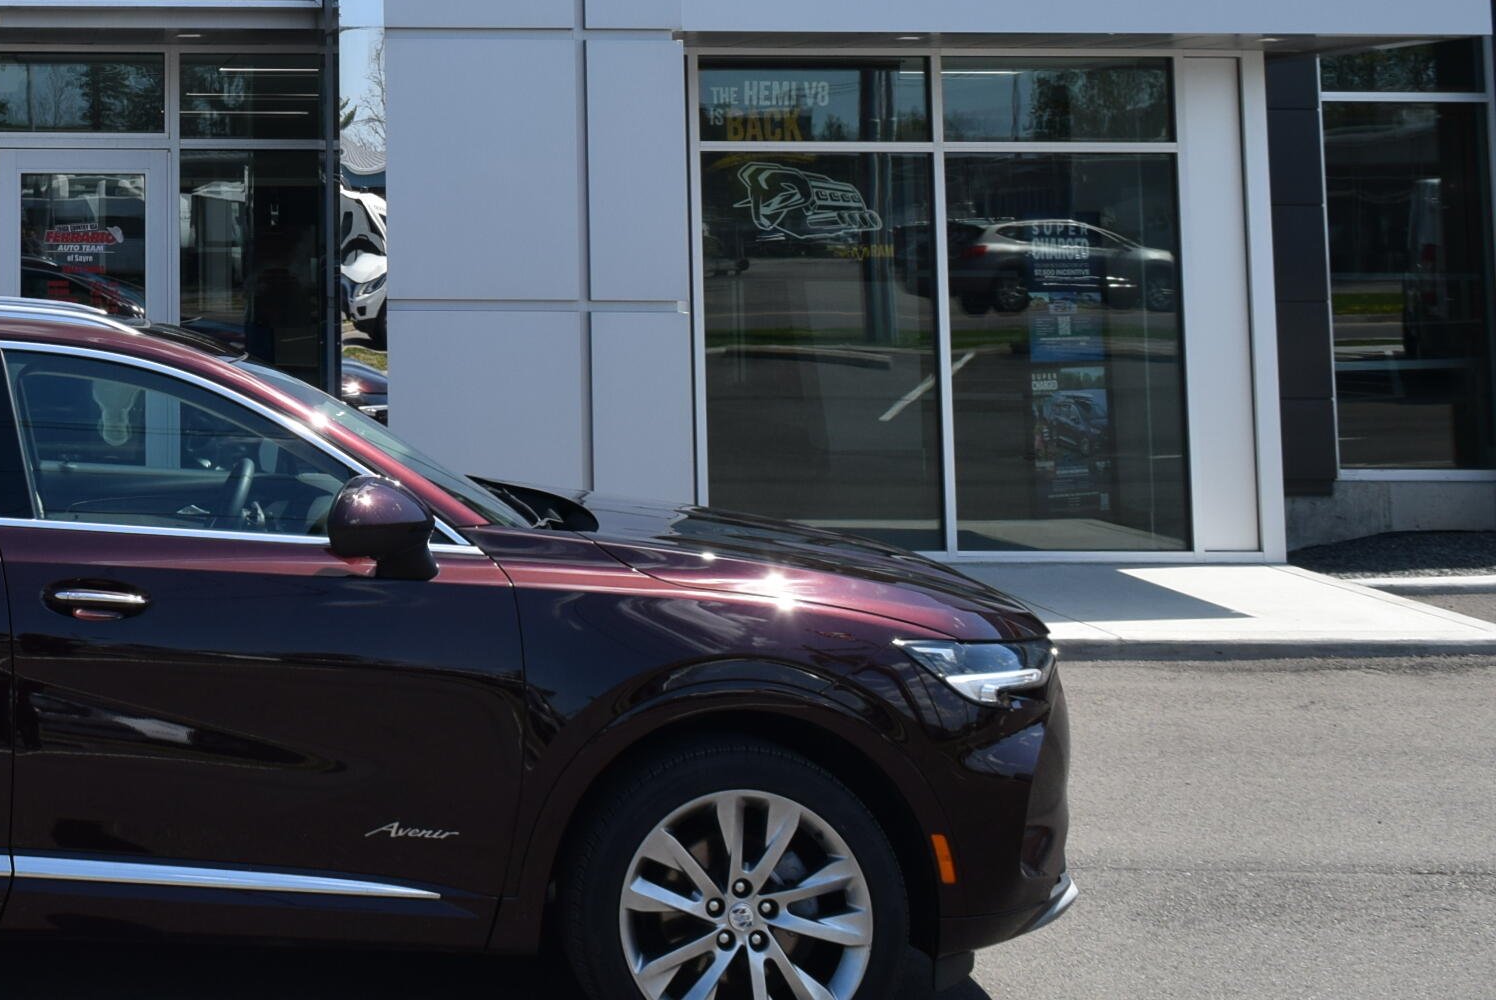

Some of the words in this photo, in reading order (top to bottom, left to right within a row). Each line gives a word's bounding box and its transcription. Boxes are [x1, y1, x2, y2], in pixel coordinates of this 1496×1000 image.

[710, 86, 739, 105] THE
[744, 80, 797, 106] HEMI
[804, 80, 830, 107] V8
[710, 106, 724, 126] IS
[726, 107, 803, 141] BACK
[1032, 222, 1089, 236] SUPER
[46, 231, 114, 244] FERRARIO
[57, 244, 80, 252] AUTO
[82, 244, 104, 253] TEAM
[1032, 238, 1090, 259] CHARGED
[66, 254, 73, 262] of
[74, 254, 94, 263] Sayre
[364, 821, 459, 839] Avenir
